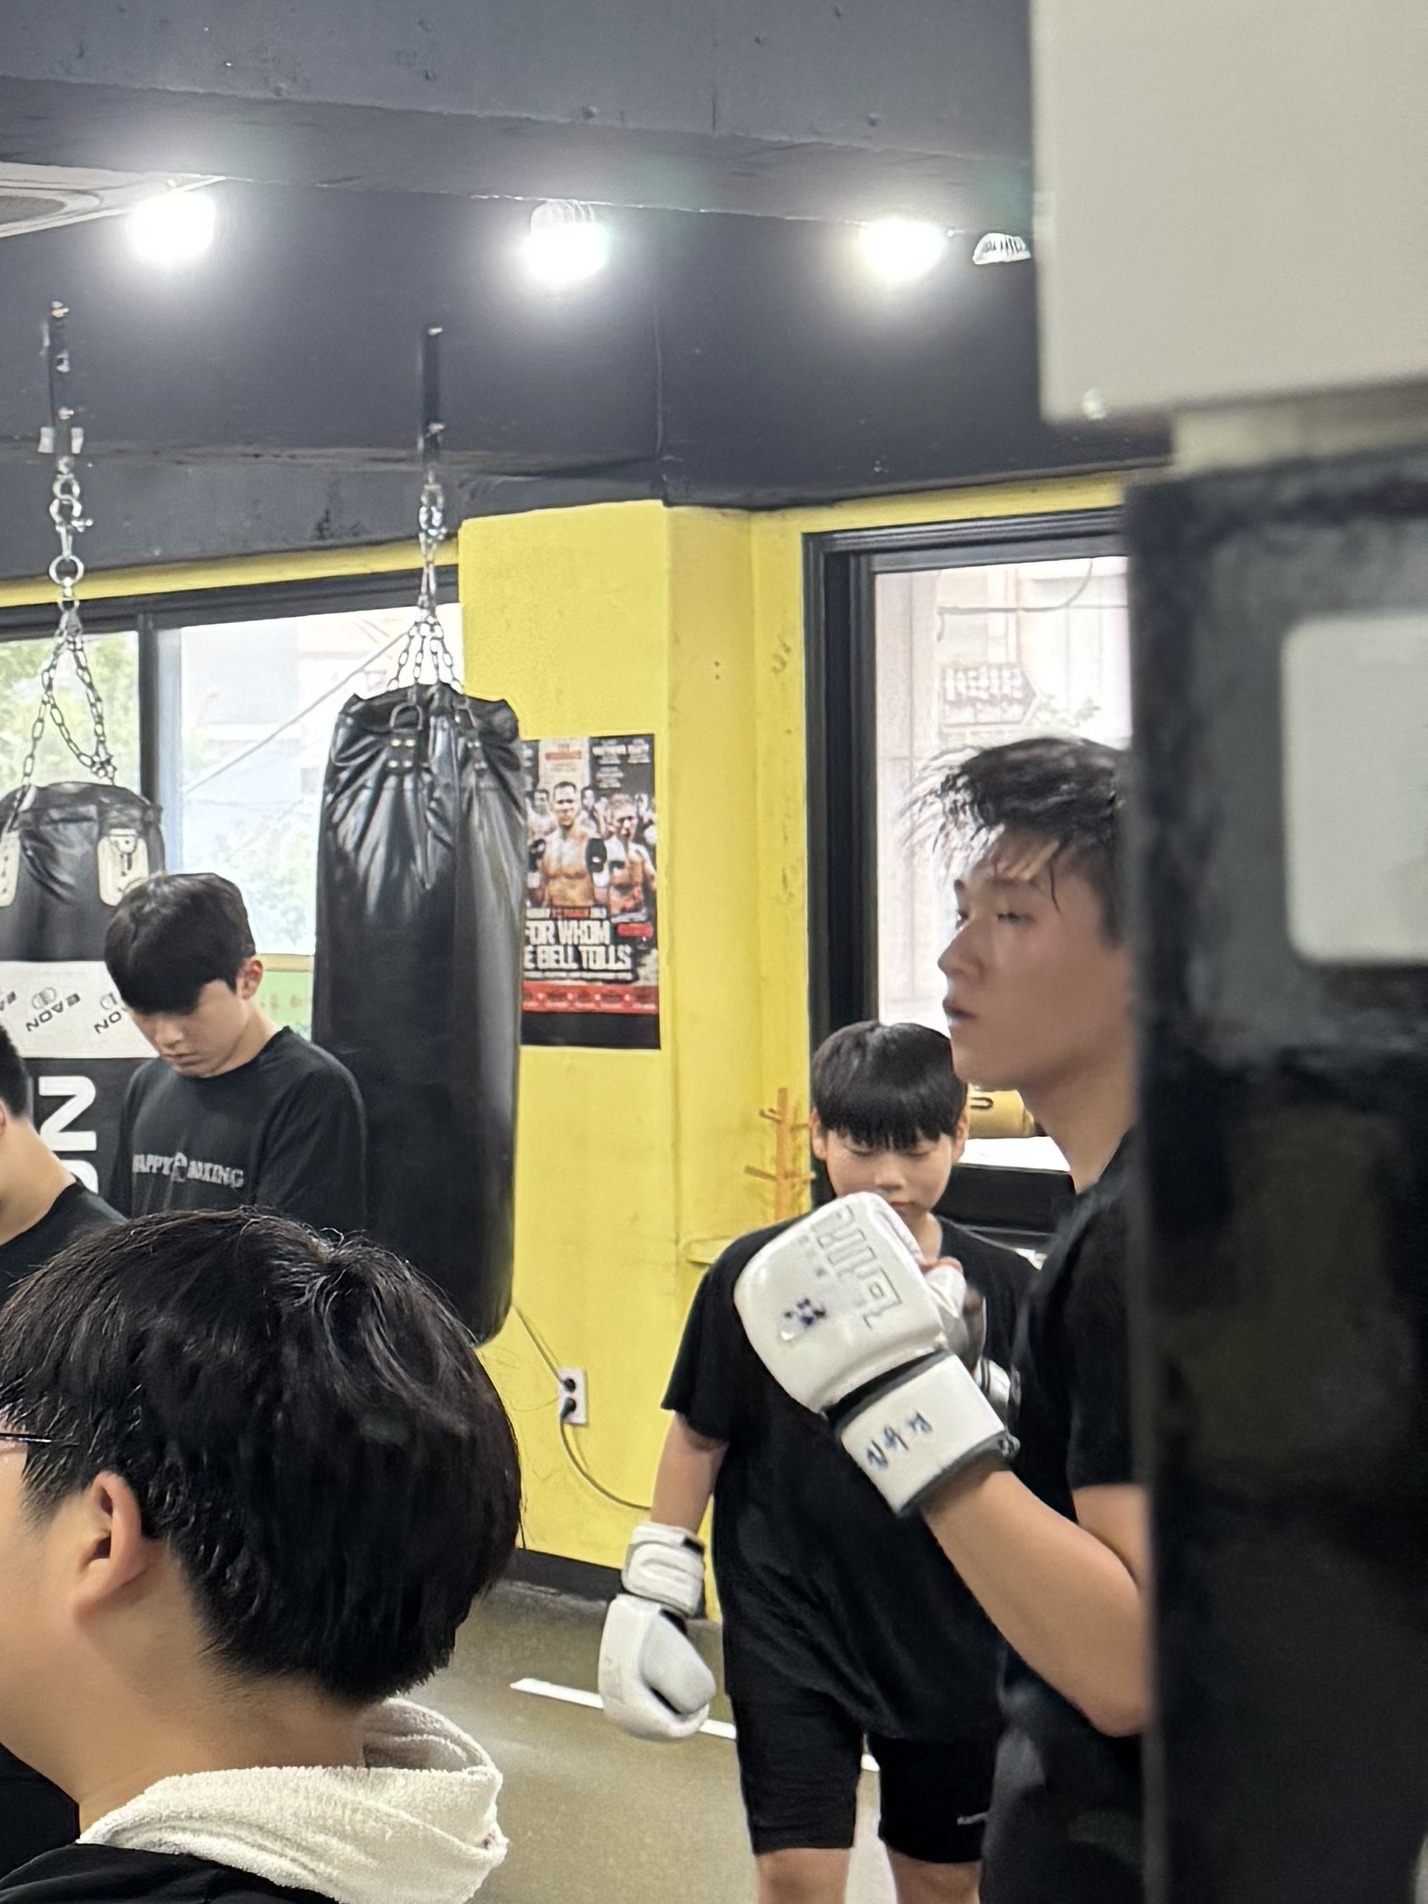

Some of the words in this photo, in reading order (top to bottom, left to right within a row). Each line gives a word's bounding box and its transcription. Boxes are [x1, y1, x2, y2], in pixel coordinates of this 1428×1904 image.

[557, 920, 611, 945] WHOM
[536, 945, 578, 970] BELL
[578, 944, 633, 971] TOLLS
